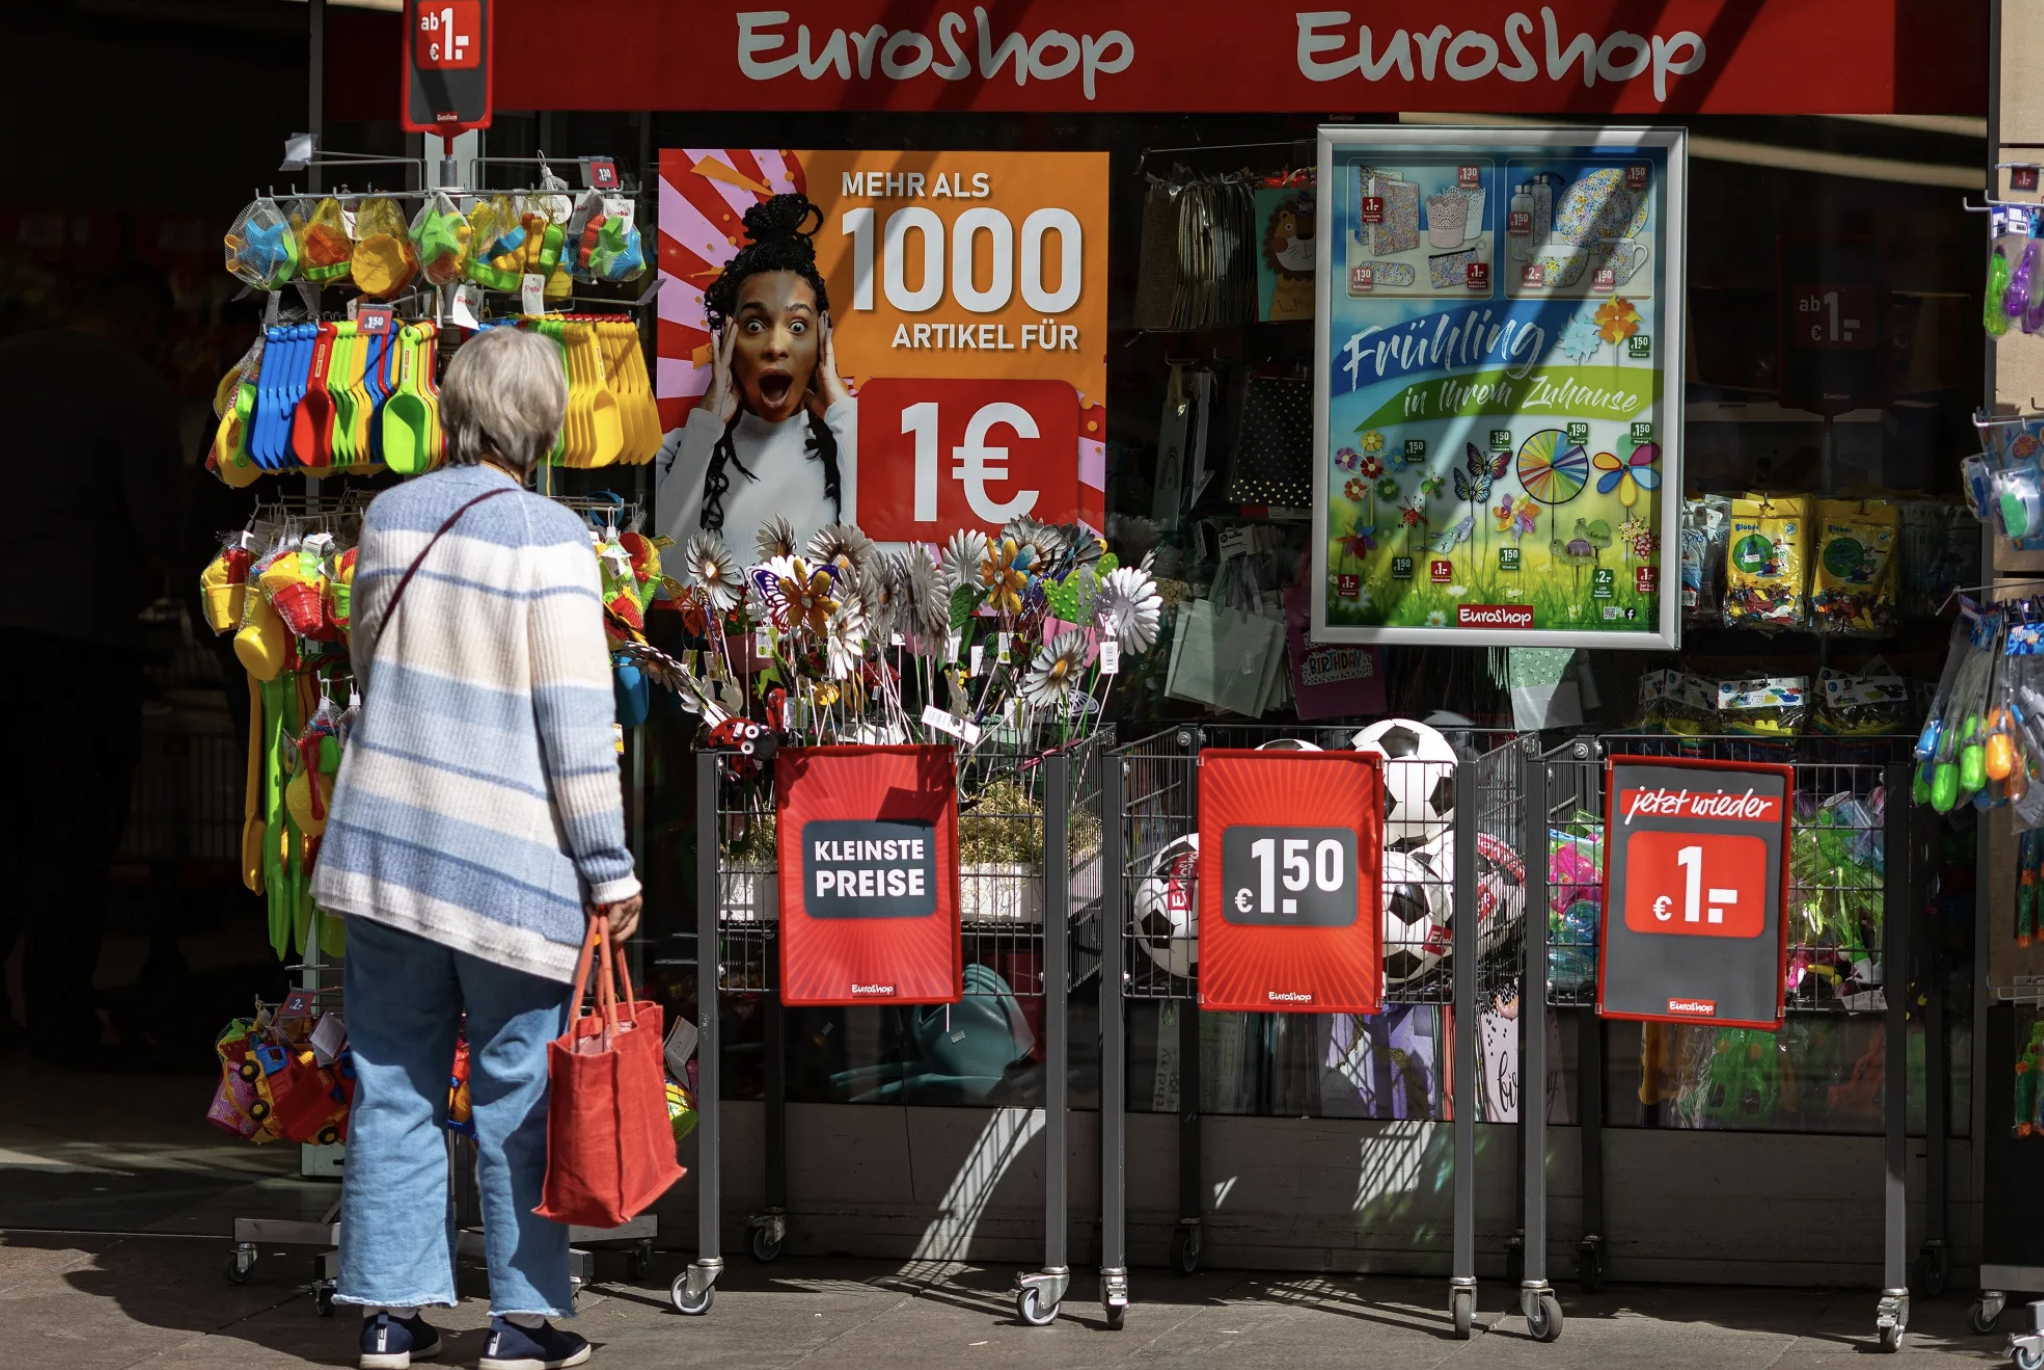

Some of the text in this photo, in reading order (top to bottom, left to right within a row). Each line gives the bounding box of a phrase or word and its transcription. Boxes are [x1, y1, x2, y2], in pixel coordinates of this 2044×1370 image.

[421, 11, 439, 31] ab
[736, 6, 1134, 100] EuroShop
[1296, 6, 1706, 102] EuroShop
[841, 171, 990, 198] MEHR ALS
[842, 207, 1082, 312] 1000
[1799, 295, 1820, 312] ab
[891, 318, 1079, 350] ARTIKEL FÜR
[1343, 310, 1546, 392] Frühling
[1404, 375, 1641, 416] in Ihrem Zuhause
[901, 401, 1041, 524] 1€
[1460, 608, 1532, 627] EuroShop
[1309, 650, 1363, 675] BIRTHDAY
[1624, 786, 1772, 825] jetzt wieder
[814, 839, 925, 862] KLEINSTE
[816, 869, 925, 897] PREISE
[851, 983, 894, 996] EuroShop
[1268, 991, 1312, 1003] EuroShop
[1669, 1001, 1714, 1014] EuroShop
